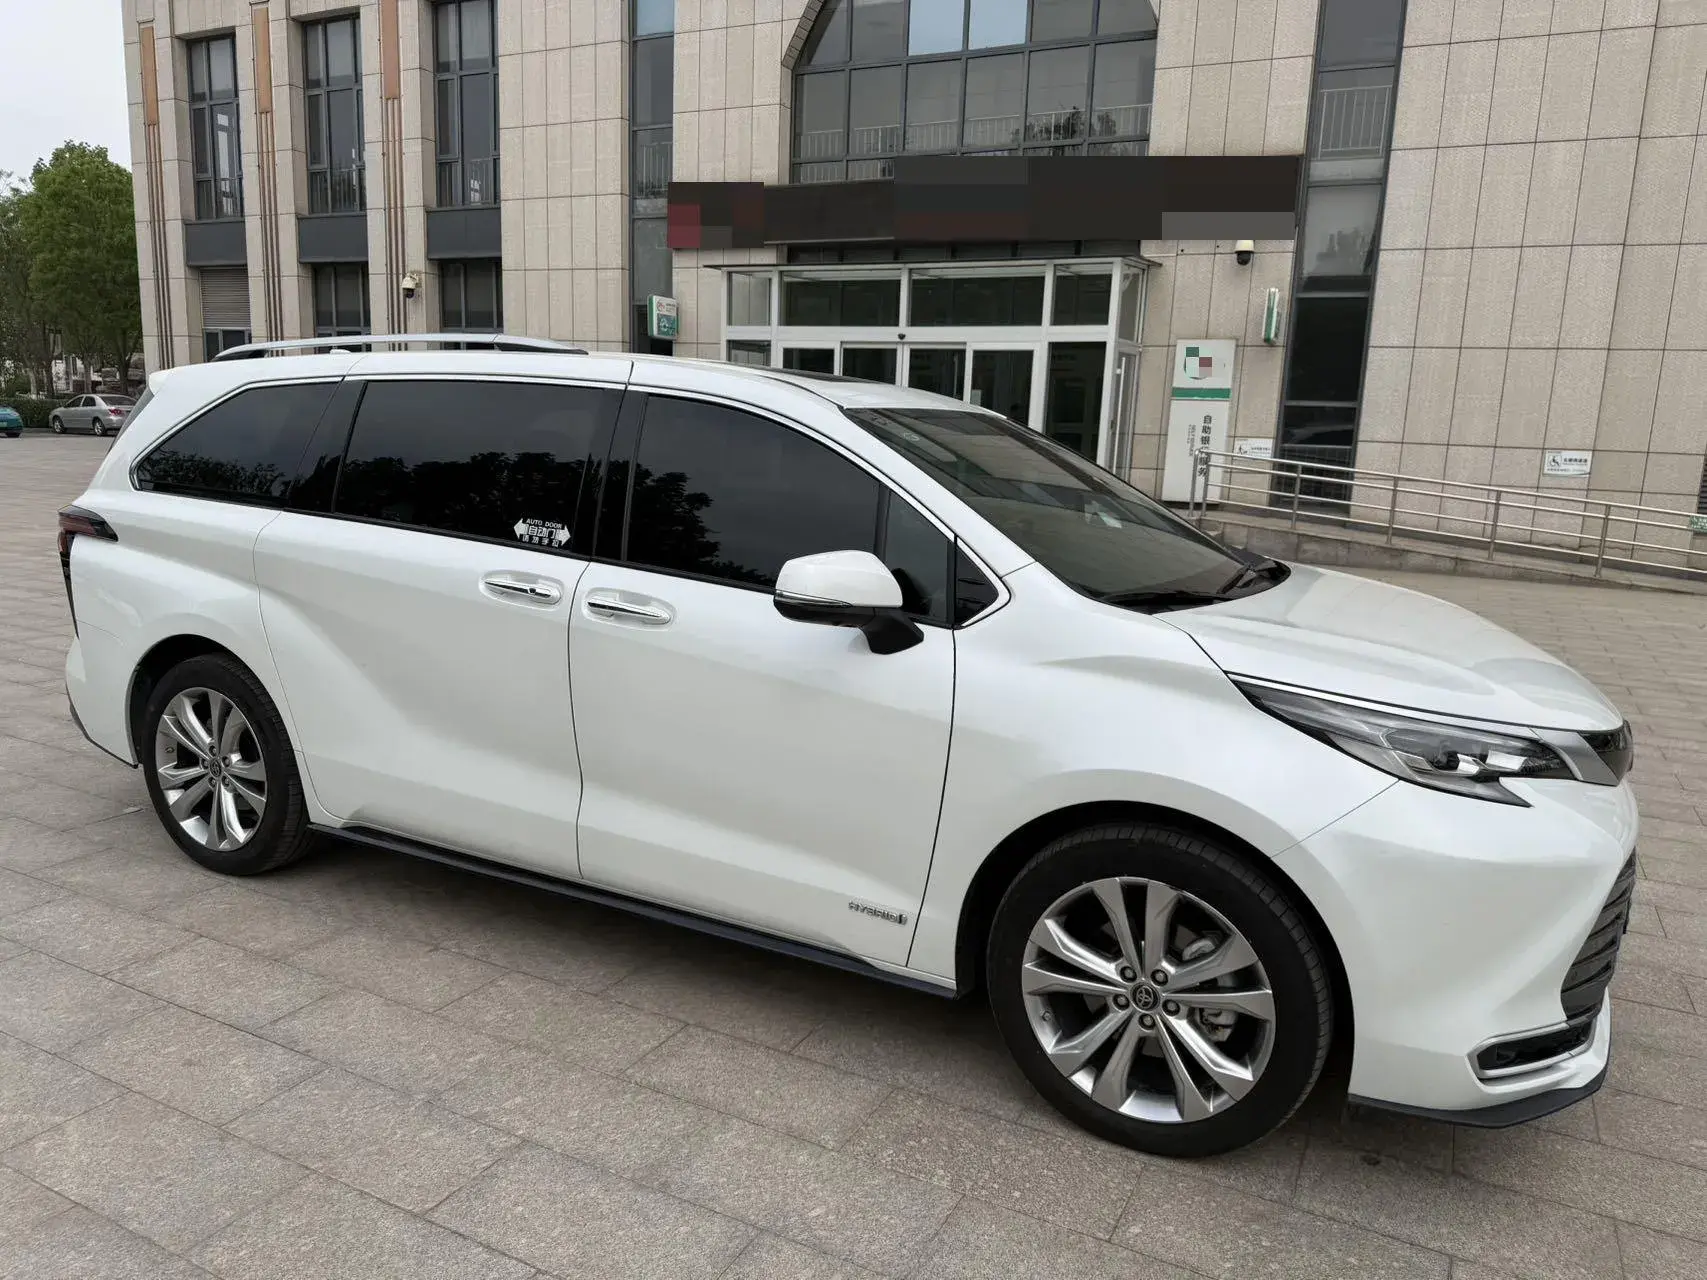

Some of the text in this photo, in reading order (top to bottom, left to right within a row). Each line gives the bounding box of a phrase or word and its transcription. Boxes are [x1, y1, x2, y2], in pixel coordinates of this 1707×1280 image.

[526, 518, 562, 529] AUTO DOOR
[529, 525, 556, 539] 自动门
[848, 901, 897, 922] HYBRID
